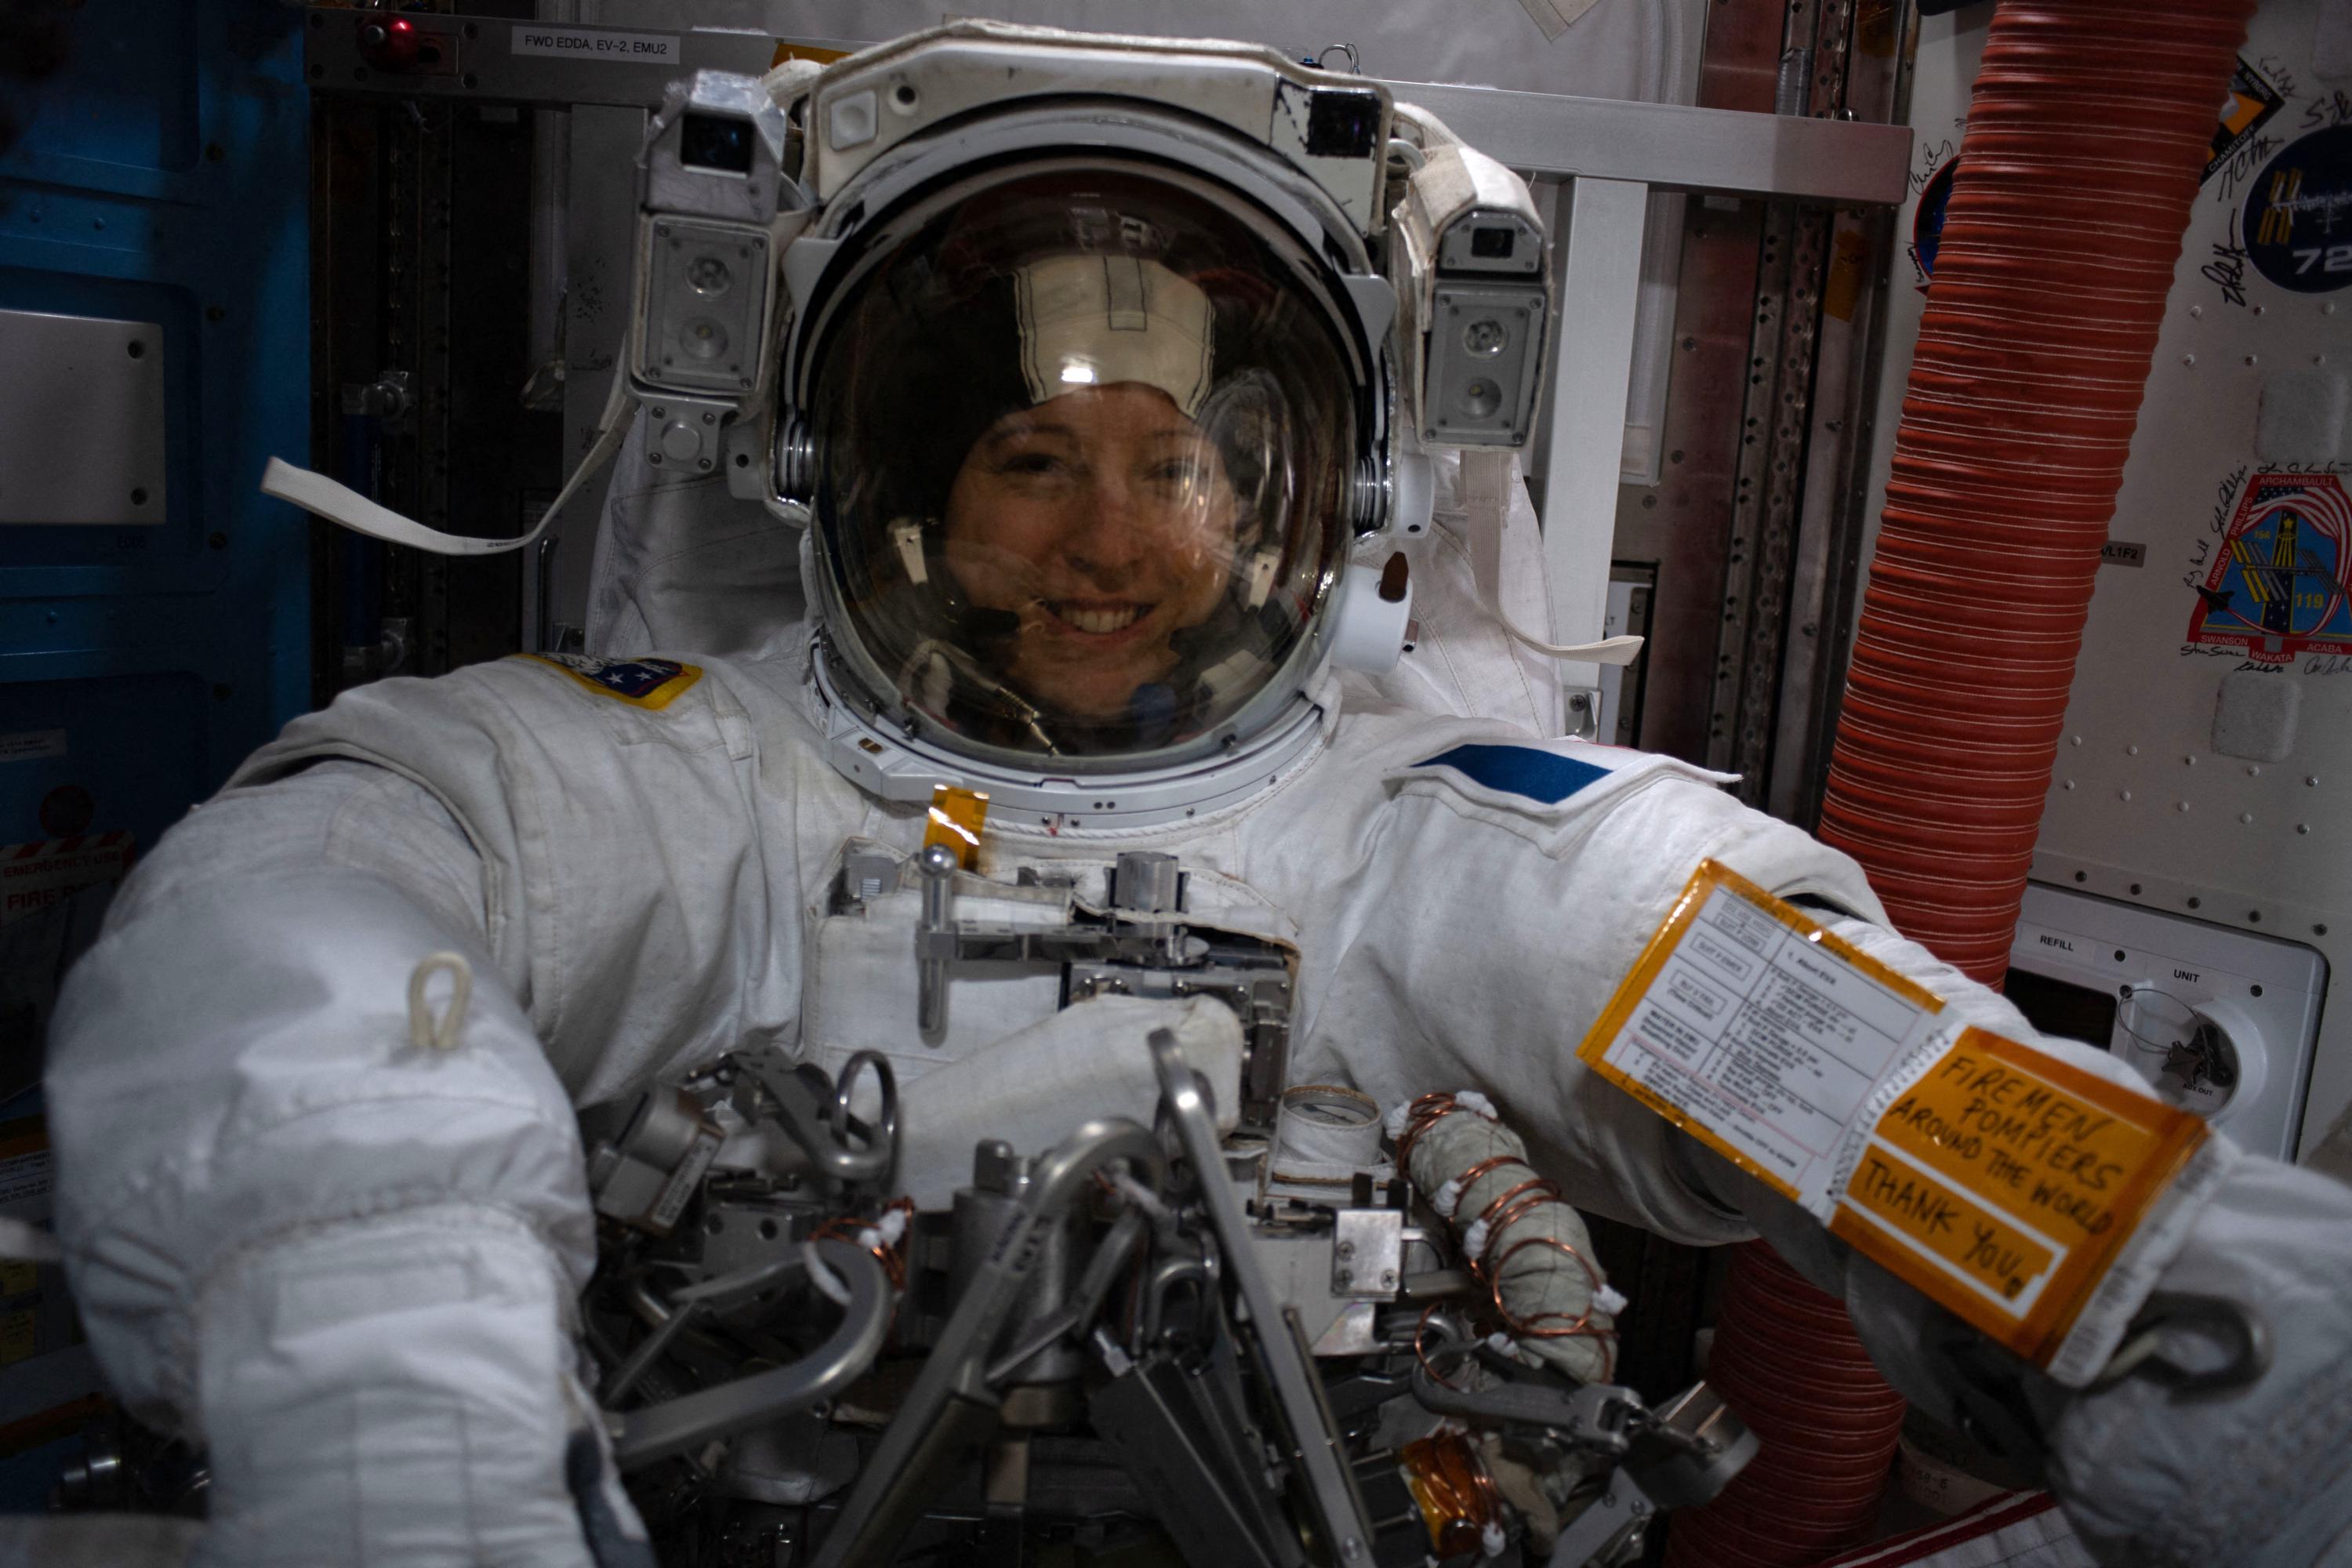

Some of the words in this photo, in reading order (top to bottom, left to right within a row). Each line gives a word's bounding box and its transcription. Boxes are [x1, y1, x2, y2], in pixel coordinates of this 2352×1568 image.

[524, 35, 554, 48] FWD
[557, 37, 593, 51] EDDA,
[597, 40, 630, 53] EV-2,
[633, 42, 667, 55] EMU2
[2292, 245, 2352, 275] 72
[2258, 476, 2335, 488] ARCHAMBAULT
[2230, 496, 2253, 536] PHILLIPS
[2211, 548, 2231, 586] ARNOLD
[2296, 593, 2325, 609] 119
[2201, 635, 2249, 647] SWANSON
[2307, 642, 2343, 654] ACABA
[2252, 651, 2294, 663] WAKATA
[4, 854, 89, 878] EMERGENCY
[93, 851, 120, 865] USE
[7, 890, 56, 910] FIRE
[2039, 935, 2074, 953] REFILL
[2173, 969, 2200, 984] UNIT
[1941, 1055, 2115, 1141] FIREMEN
[2182, 1083, 2197, 1092] AUX
[2198, 1087, 2212, 1097] OUT
[1959, 1098, 2123, 1190] POMPIERS
[1888, 1098, 1982, 1160] AROUND
[1985, 1149, 2031, 1189] THE
[2031, 1181, 2114, 1235] WORLD
[1863, 1159, 1962, 1235] THANK
[1963, 1221, 2024, 1276] YOU
